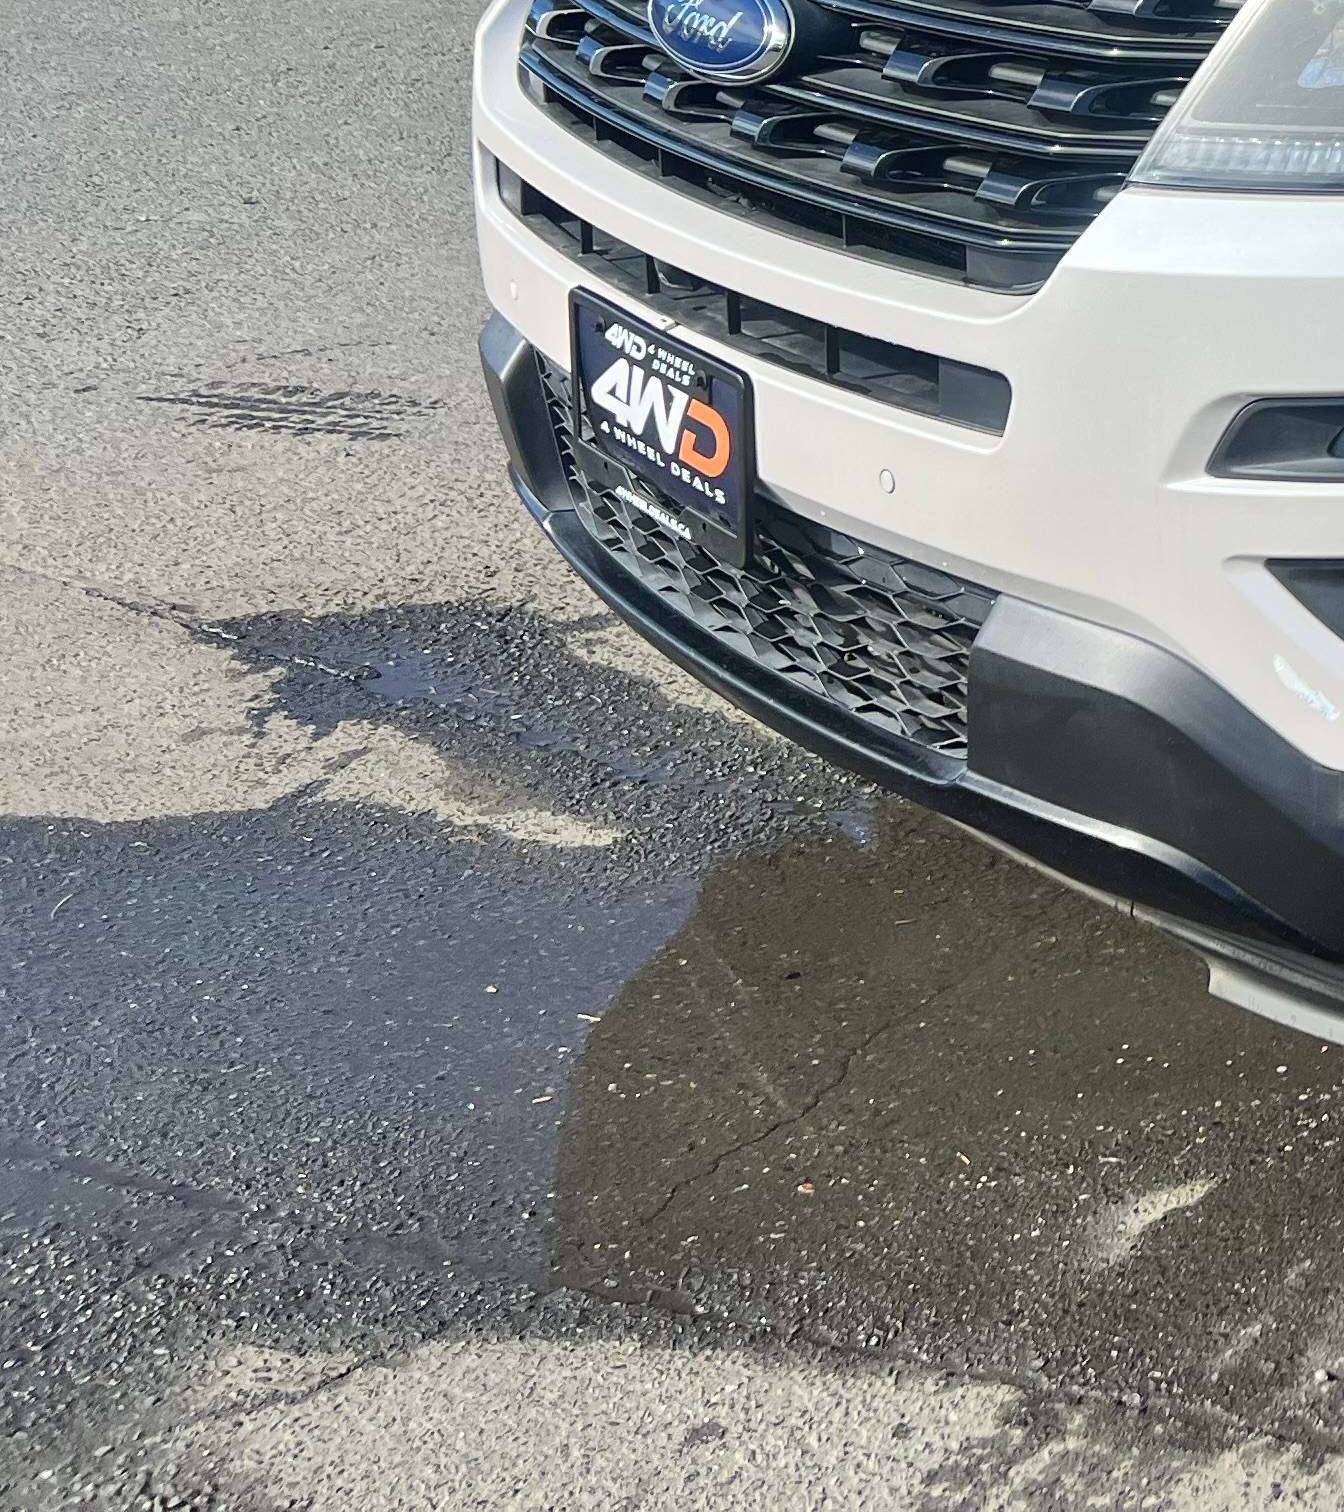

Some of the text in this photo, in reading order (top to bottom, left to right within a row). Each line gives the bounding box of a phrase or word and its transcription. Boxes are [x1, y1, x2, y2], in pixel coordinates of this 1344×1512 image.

[604, 323, 647, 361] 4WD
[652, 358, 691, 387] DEALS
[657, 347, 696, 376] WHEEL
[590, 357, 730, 478] 4WD
[613, 426, 666, 468] WHEEL
[670, 461, 726, 505] DEALS
